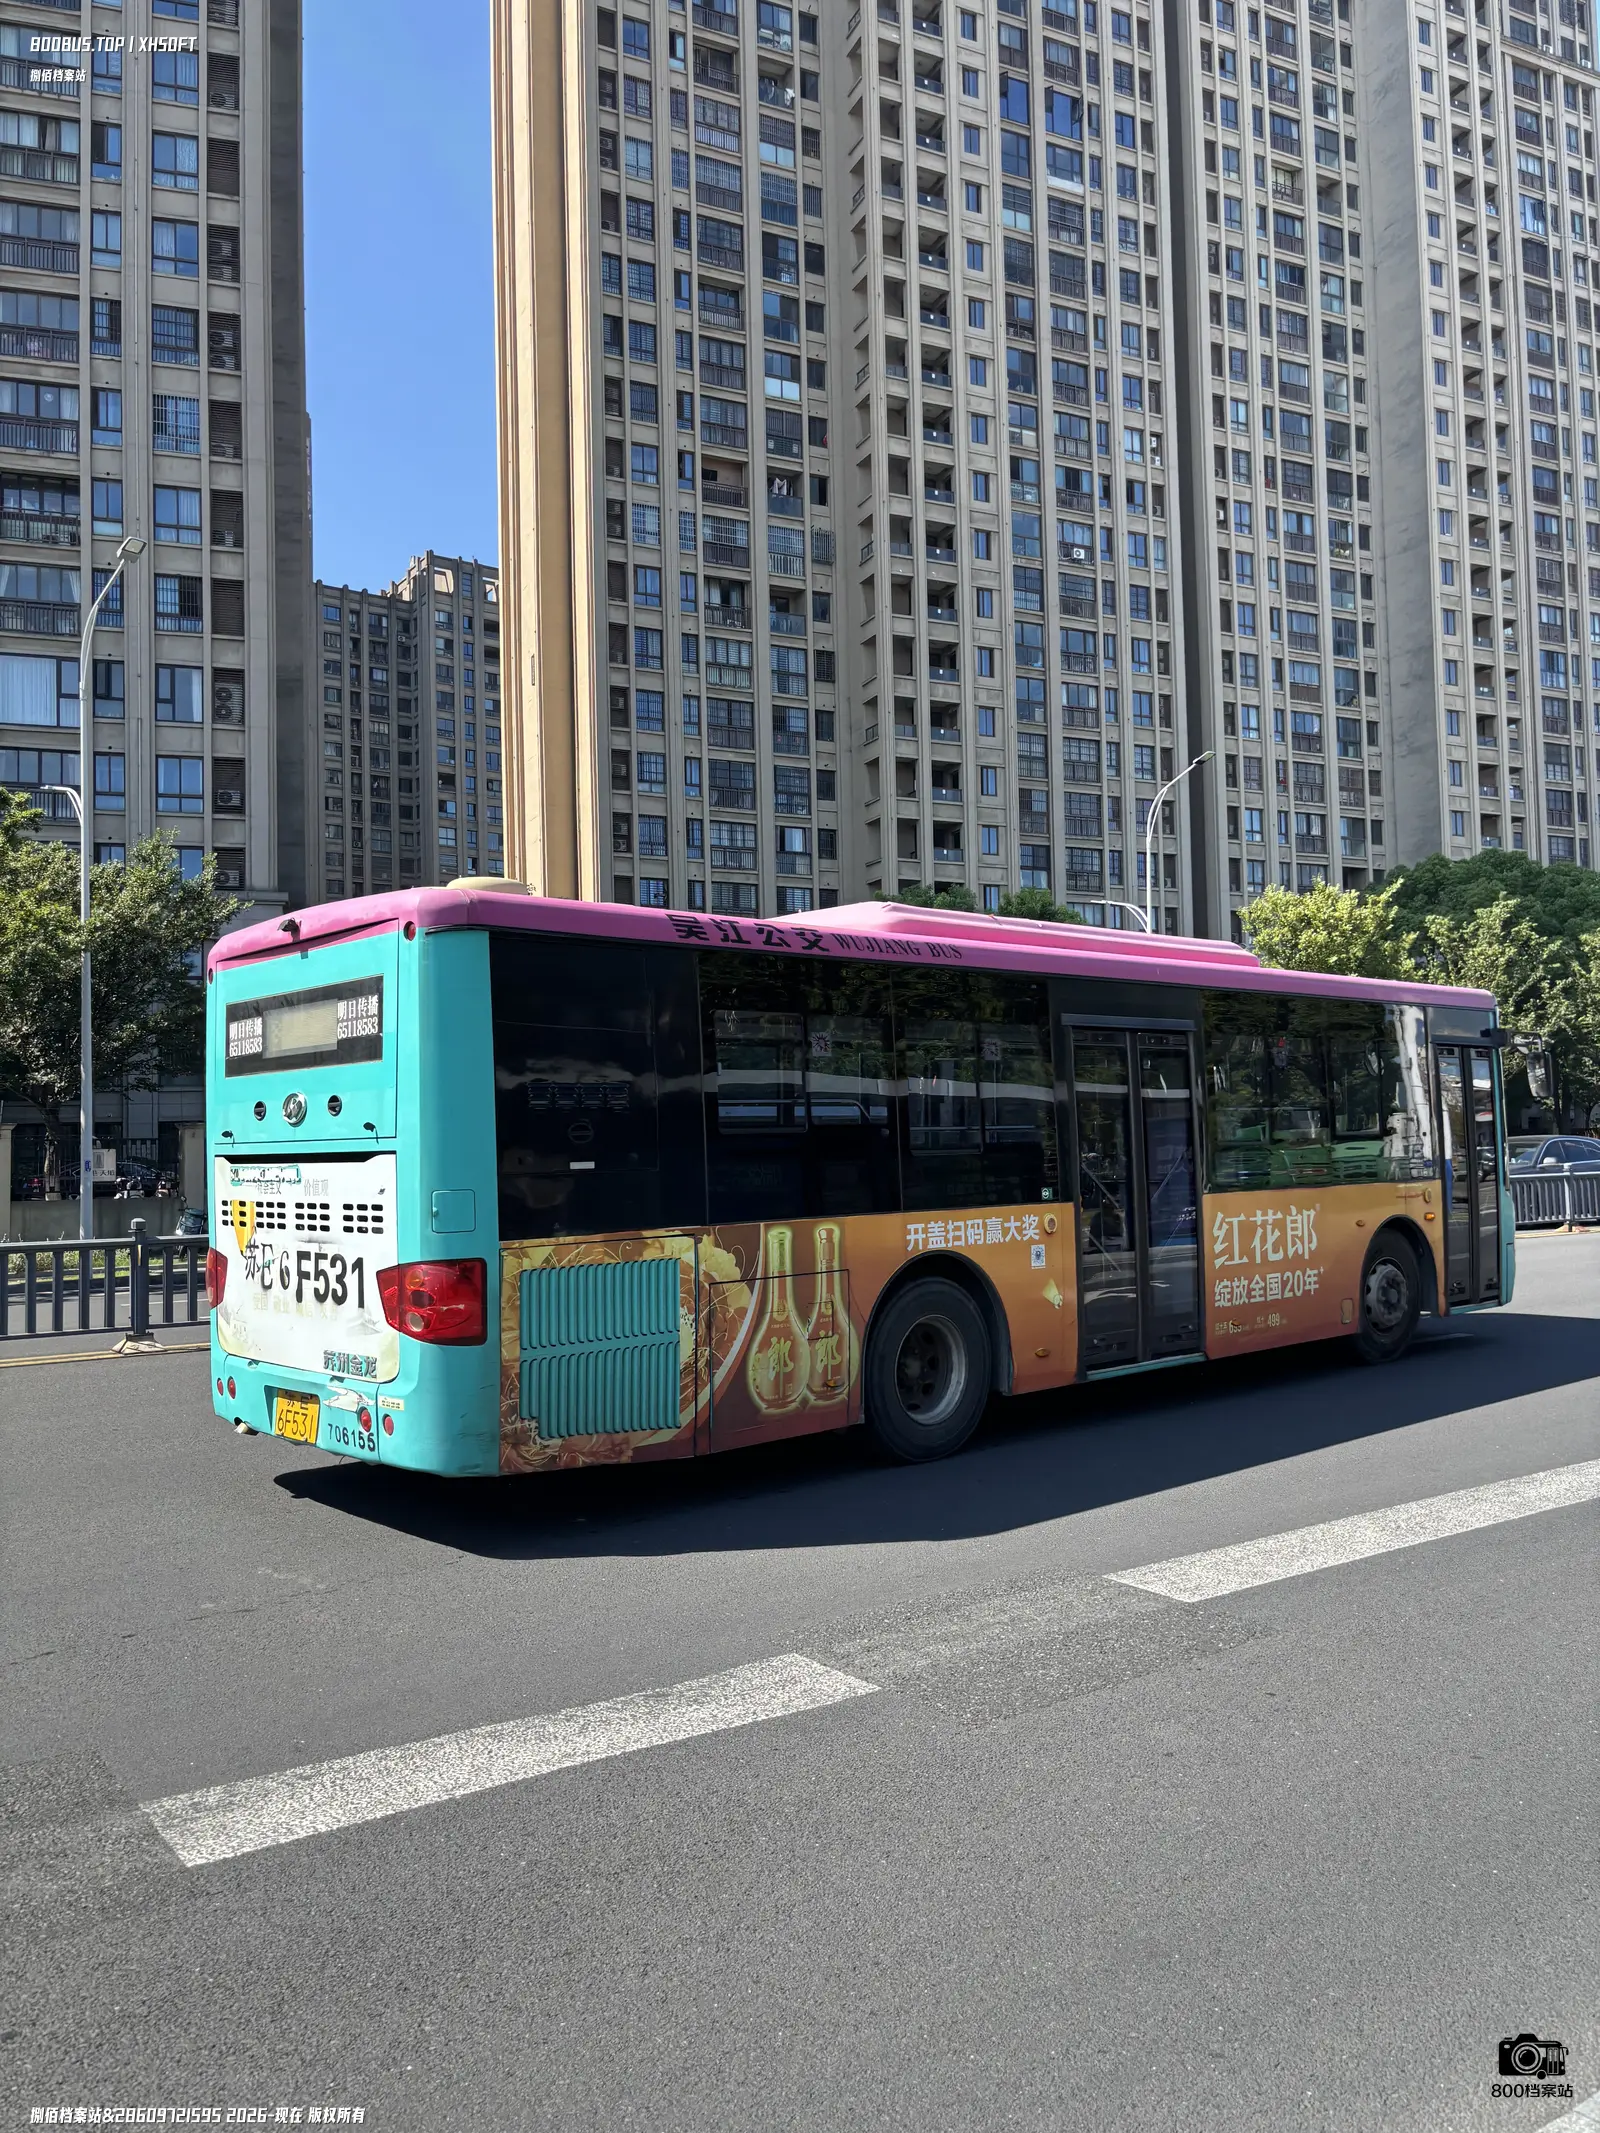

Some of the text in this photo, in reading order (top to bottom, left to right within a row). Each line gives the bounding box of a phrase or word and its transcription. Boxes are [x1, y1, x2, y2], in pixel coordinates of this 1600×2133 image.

[665, 913, 963, 960] 吴江公交 WUJIANG BUS
[337, 994, 379, 1021] 明日传播
[229, 1017, 262, 1041] 明日传播
[337, 1016, 378, 1040] 65118583
[229, 1036, 262, 1057] 65118583
[906, 1214, 1040, 1251] 开盖扫码赢大奖
[1212, 1204, 1319, 1270] 红花郎
[276, 1408, 314, 1440] 6F531
[327, 1422, 376, 1452] 706155
